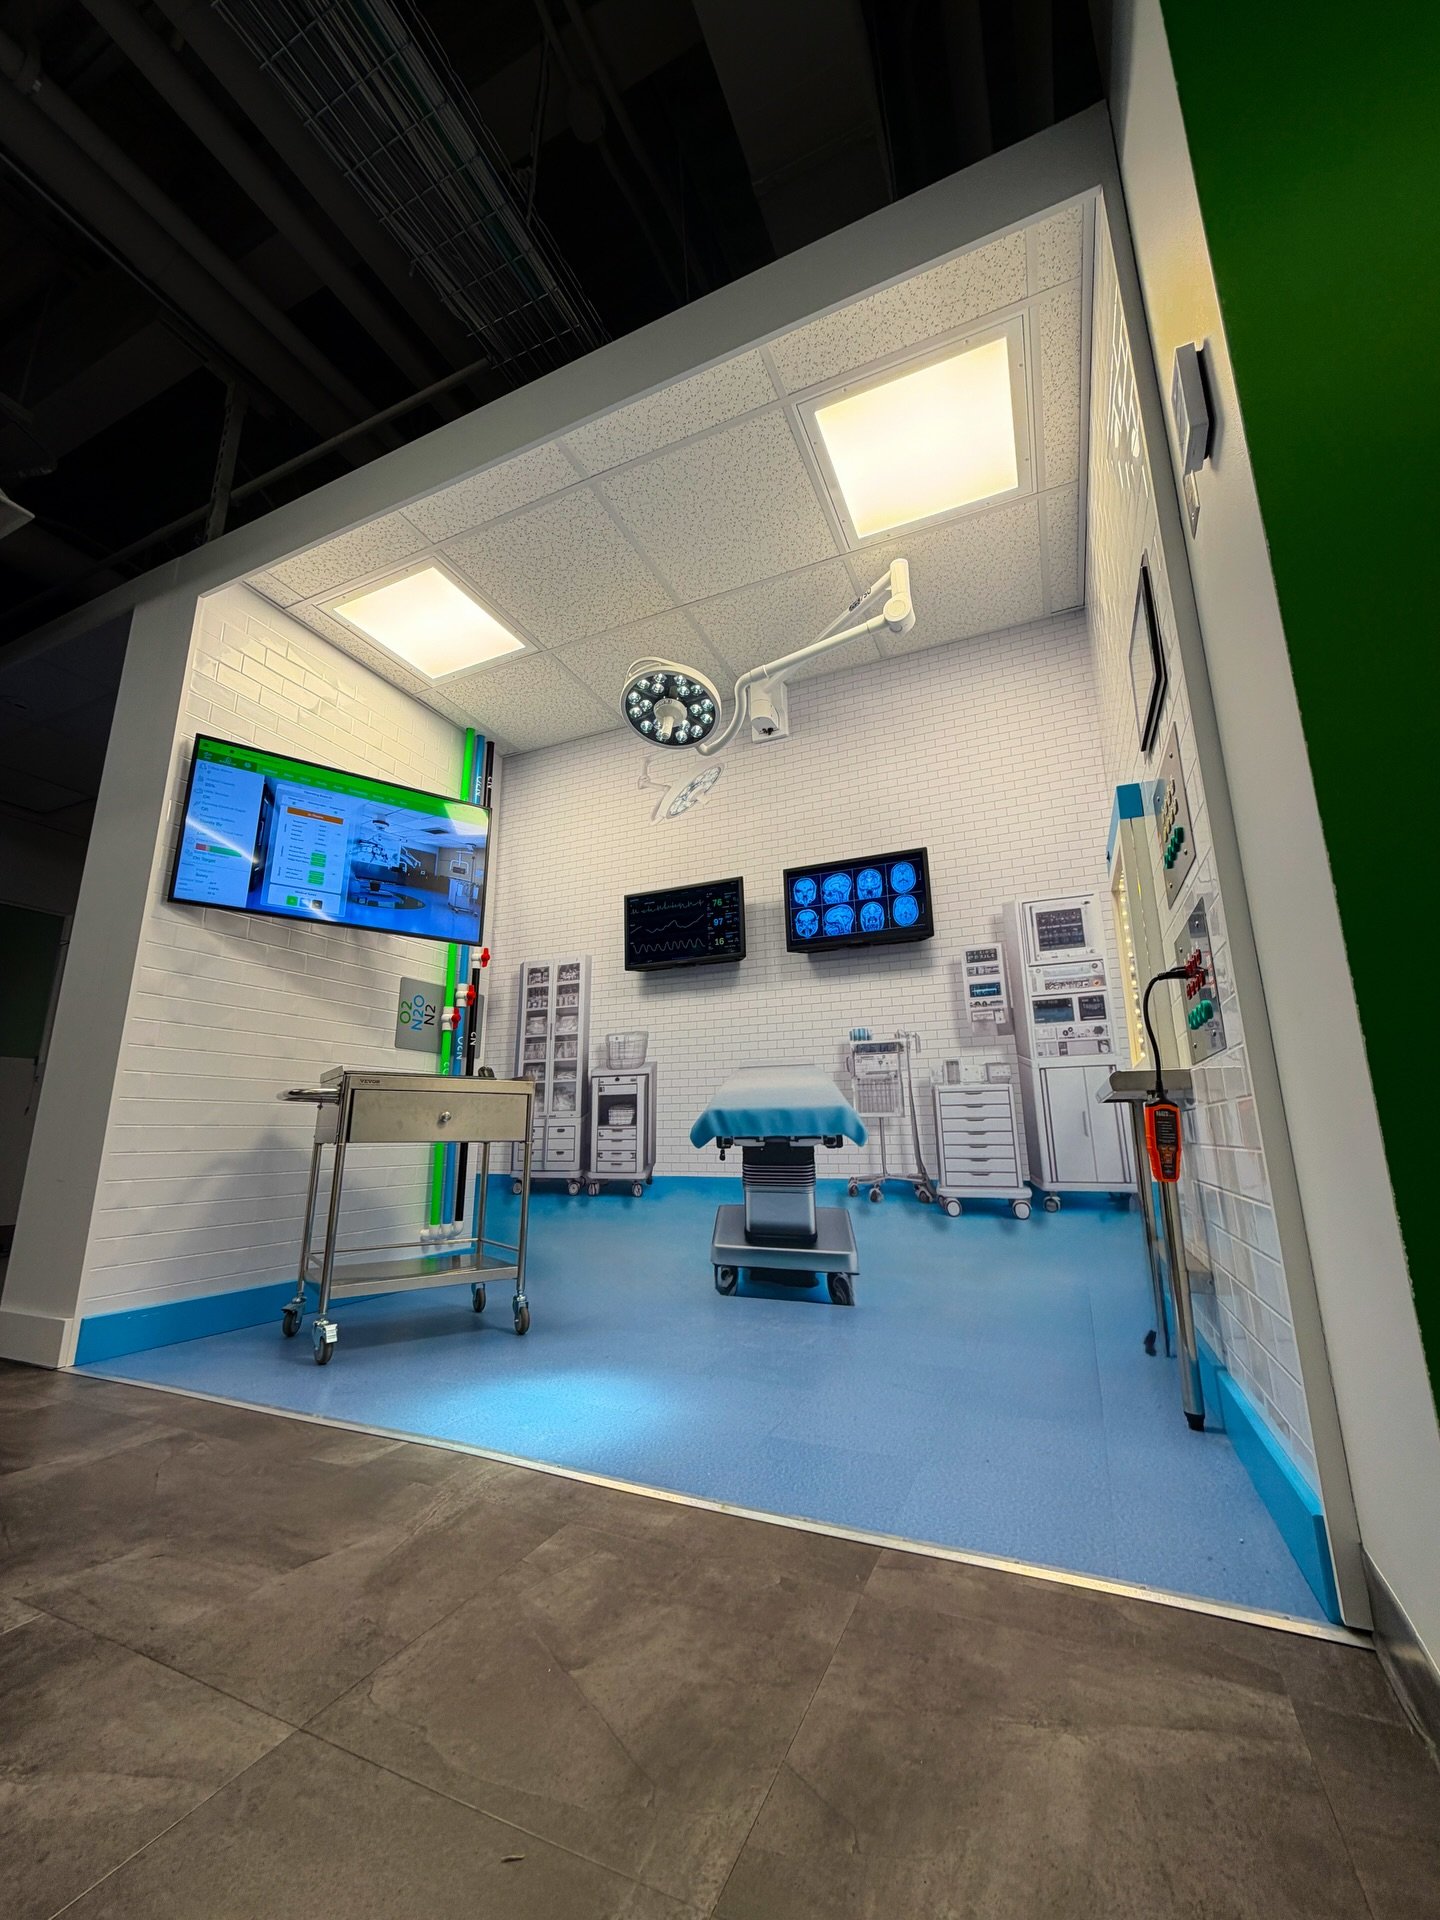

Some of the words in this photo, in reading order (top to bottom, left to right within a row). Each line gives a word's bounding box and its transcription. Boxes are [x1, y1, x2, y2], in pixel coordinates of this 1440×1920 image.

[713, 917, 724, 926] 97
[714, 937, 725, 946] 16
[400, 1001, 412, 1024] O2
[411, 994, 425, 1031] N2O
[424, 1004, 436, 1026] N2
